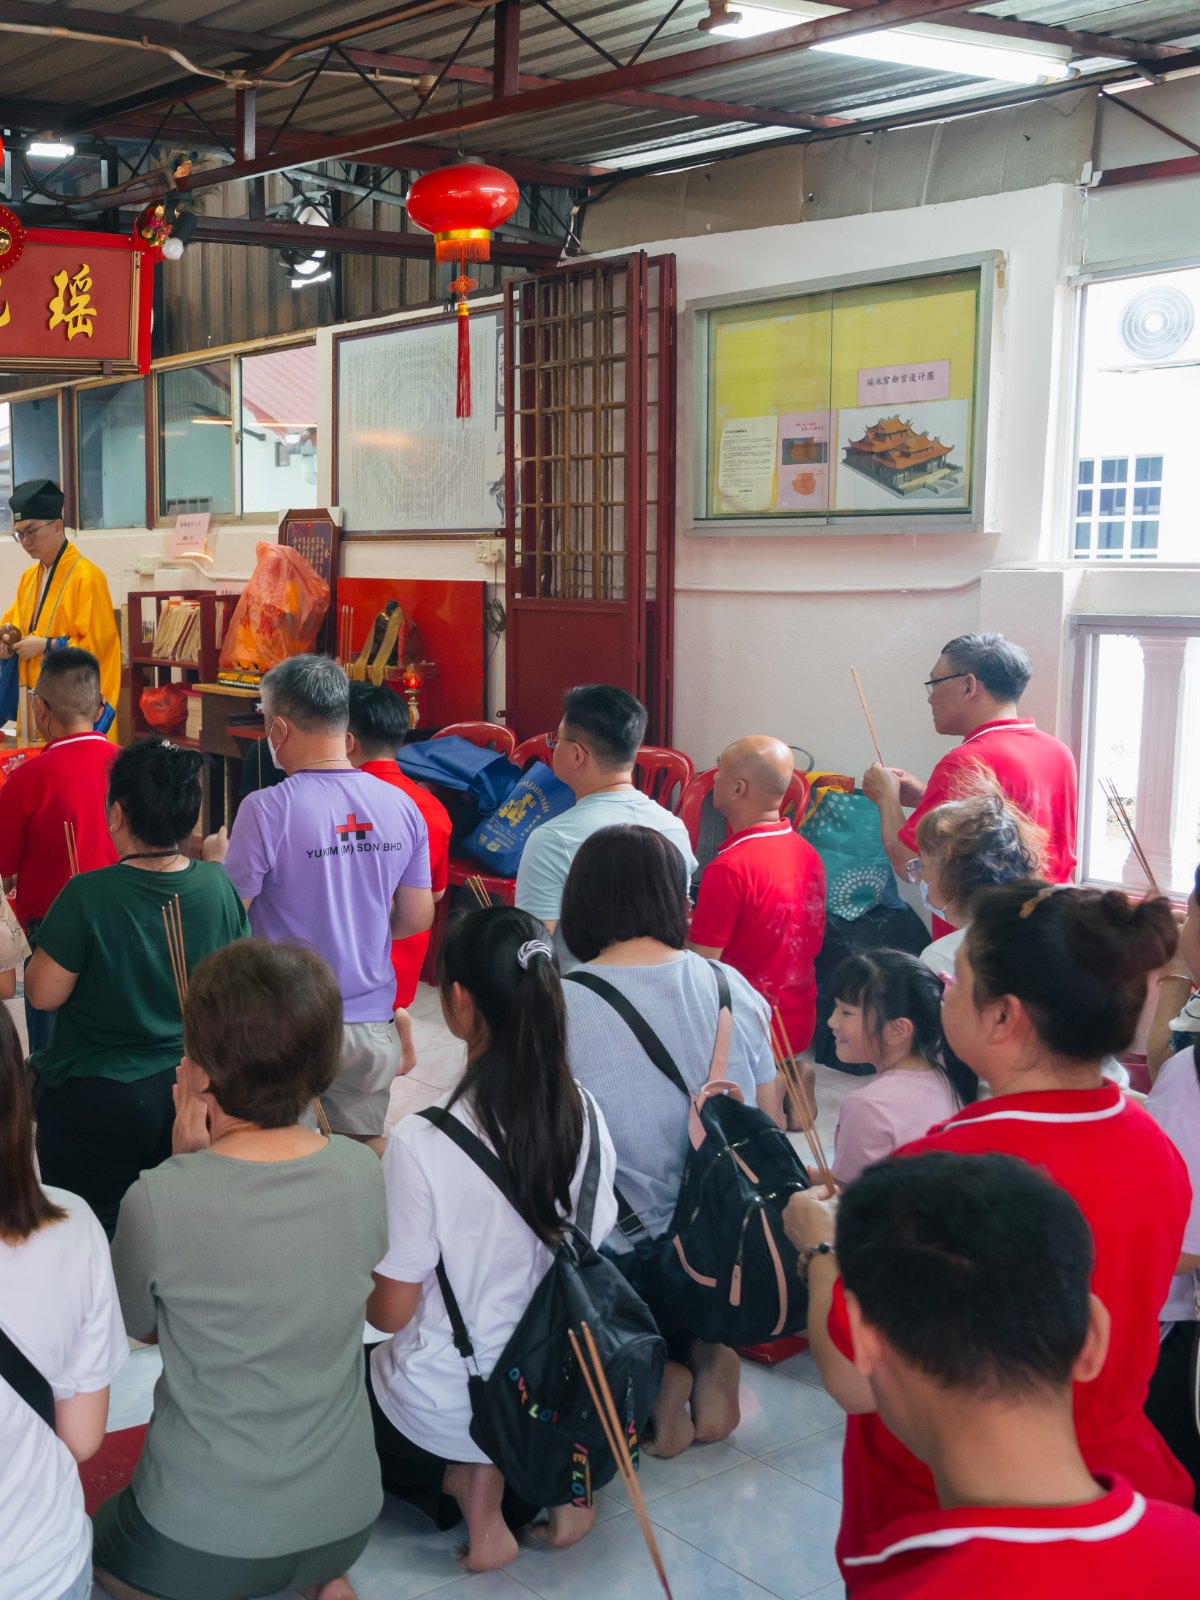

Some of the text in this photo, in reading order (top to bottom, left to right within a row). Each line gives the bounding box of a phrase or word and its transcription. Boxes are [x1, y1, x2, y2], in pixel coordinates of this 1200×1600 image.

[305, 842, 402, 859] YUKIM (M) SDN BHD
